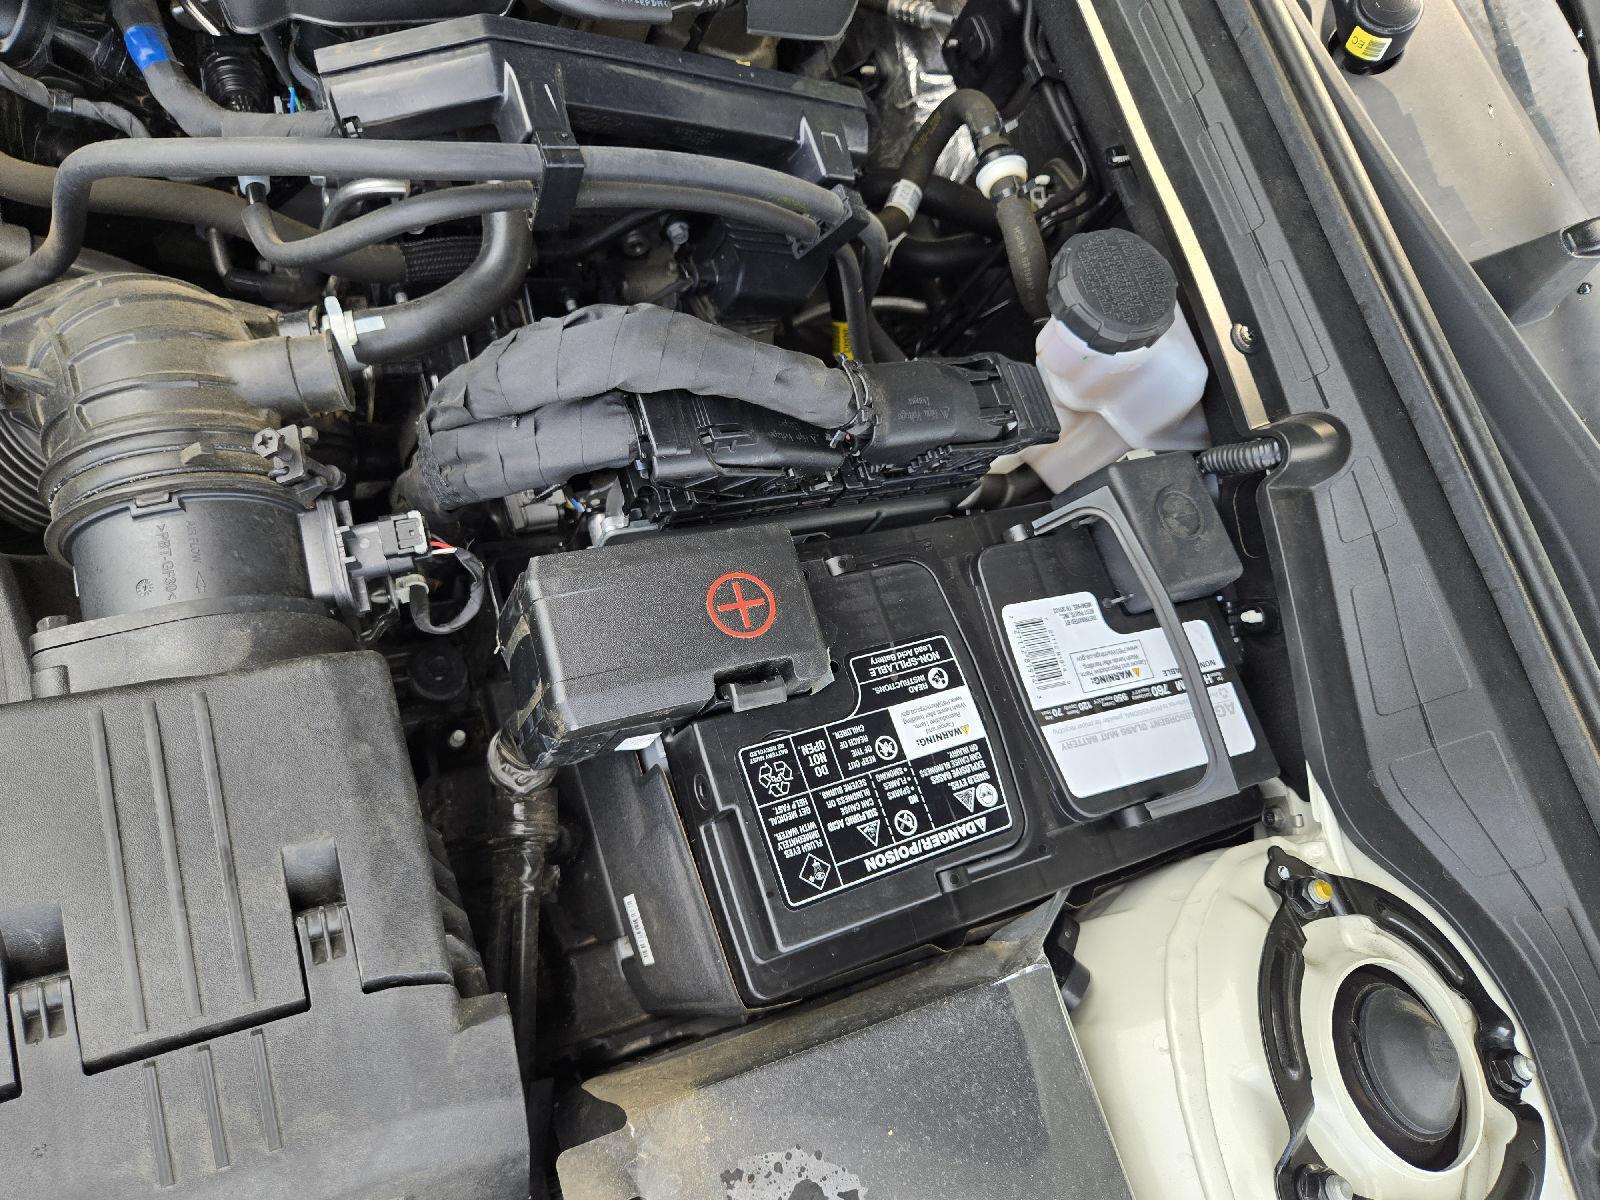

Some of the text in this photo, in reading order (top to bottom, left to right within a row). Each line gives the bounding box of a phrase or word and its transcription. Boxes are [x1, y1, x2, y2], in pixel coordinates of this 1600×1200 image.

[1350, 35, 1365, 49] EC
[184, 519, 202, 564] AIR FLOW
[868, 642, 932, 666] Lead Acid Battery
[868, 649, 940, 677] NON-SPILLABLE
[1092, 663, 1121, 675] Reproductive
[1160, 658, 1216, 677] NONABLE
[871, 673, 926, 695] INSTRUCTIONS.
[1089, 668, 1133, 687] WARNING:
[907, 681, 928, 694] READ
[1149, 681, 1170, 697] 760
[1076, 699, 1093, 712] 120
[1112, 691, 1129, 703] 950
[1050, 706, 1064, 718] 70
[831, 722, 865, 741] CHILDREN.
[914, 726, 963, 748] WARNING:
[1099, 729, 1119, 741] MAT
[1119, 721, 1148, 736] GLASS
[796, 738, 827, 756] OPEN.
[837, 732, 869, 749] REACH OF
[1059, 733, 1098, 751] BATTERY
[747, 743, 777, 758] RECYCLED
[748, 746, 789, 765] BATTERY MUST
[806, 750, 828, 768] NOT
[849, 744, 873, 758] OF THE
[946, 742, 978, 758] OR INJURY.
[813, 763, 830, 778] DO
[845, 753, 877, 771] KEEP OUT
[918, 750, 982, 778] CAN CAUSE BLINDNESS
[873, 765, 904, 782] SMOKING
[929, 758, 986, 785] EXPLOSIVE GASES
[946, 769, 991, 791] SHIELD EYES.
[818, 777, 867, 800] SEVERE BURNS.
[881, 775, 907, 790] FLAMES
[824, 787, 871, 809] BLINDNESS OR
[885, 784, 911, 800] SPARKS
[906, 793, 919, 805] NO
[771, 796, 808, 815] HELP FAST.
[838, 796, 875, 815] CAN CAUSE
[767, 805, 812, 827] GET MEDICAL
[825, 806, 879, 832] SULFURIC ACID
[772, 820, 817, 842] WITH WATER.
[775, 828, 820, 851] IMMEDIATELY
[782, 837, 824, 858] FLUSH EYES
[862, 820, 978, 872] DANGER/POISON
